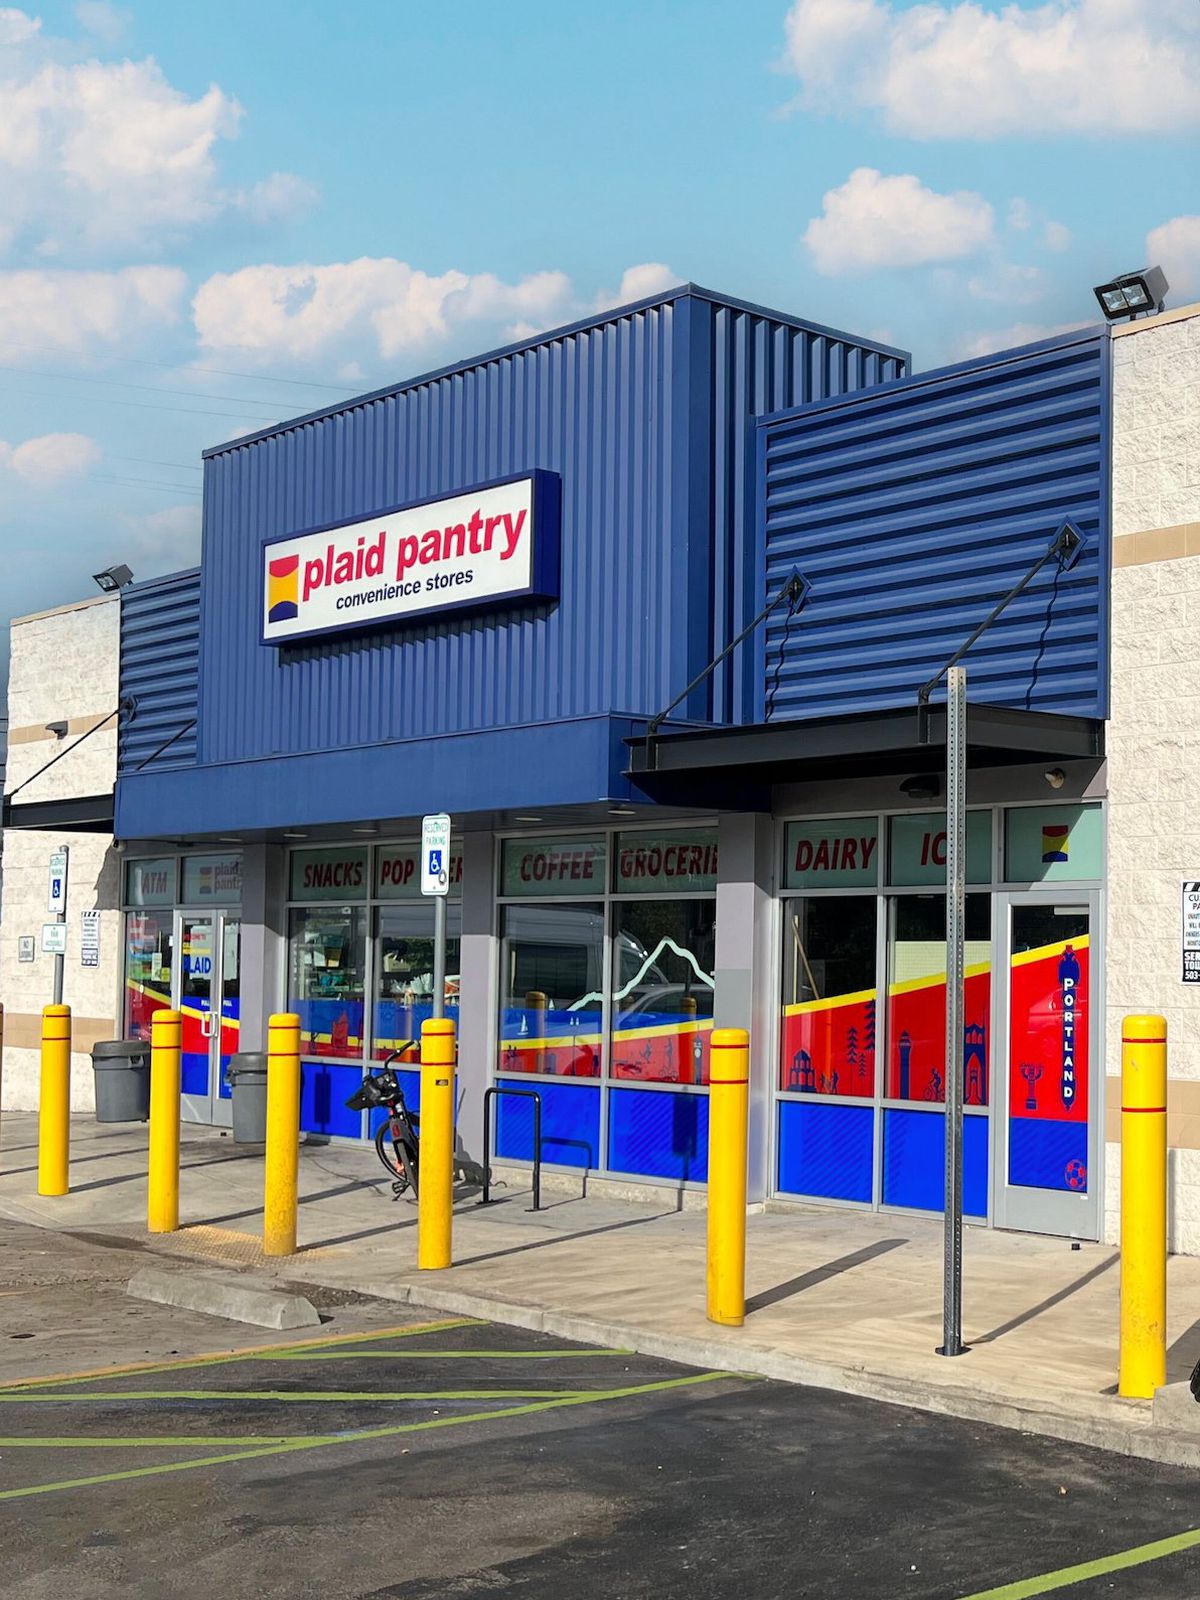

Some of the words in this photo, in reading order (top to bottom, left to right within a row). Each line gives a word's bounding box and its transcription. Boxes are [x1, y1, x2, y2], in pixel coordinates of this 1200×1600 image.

[302, 531, 387, 602] plaid
[396, 507, 529, 582] pantry
[336, 578, 422, 611] convenience
[425, 568, 474, 592] stores
[620, 844, 718, 878] GROCERI
[795, 836, 877, 872] DAIRY
[920, 831, 948, 866] IC
[142, 871, 168, 895] ATM
[303, 860, 363, 888] SNACKS
[381, 858, 415, 886] POP
[520, 850, 595, 882] COFFEE
[214, 876, 240, 894] pantr
[1063, 978, 1075, 1098] PORTLAND
